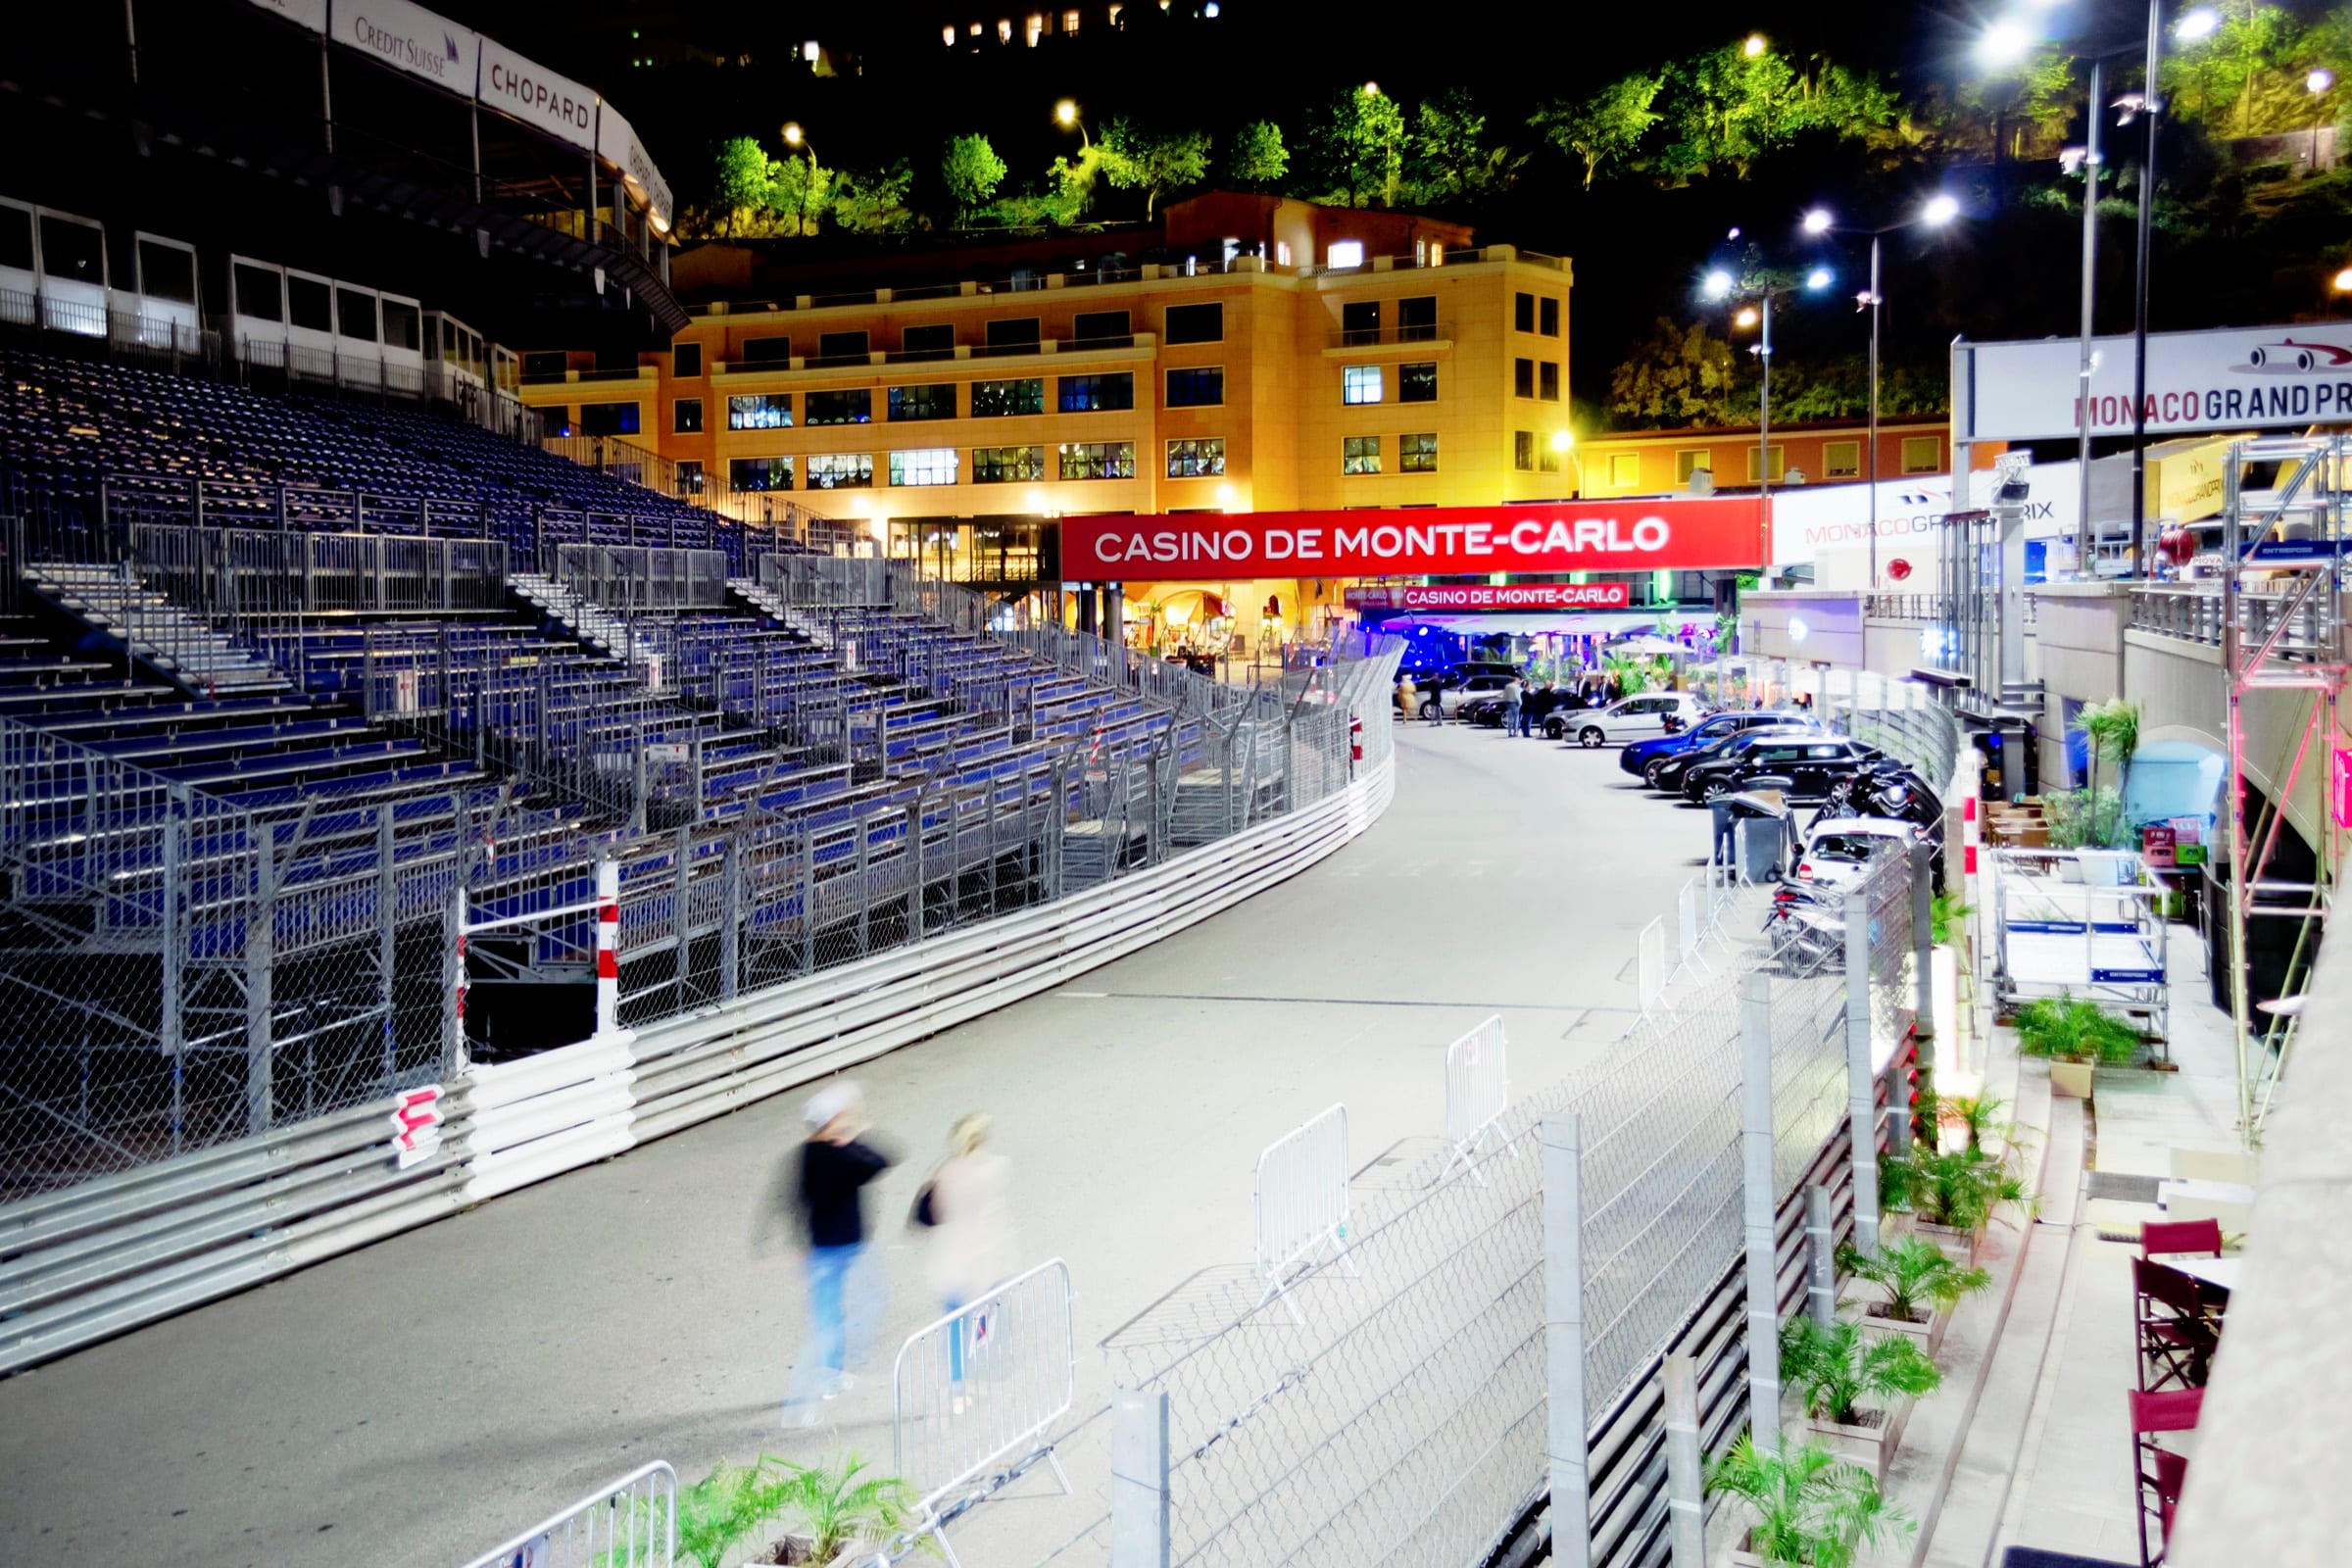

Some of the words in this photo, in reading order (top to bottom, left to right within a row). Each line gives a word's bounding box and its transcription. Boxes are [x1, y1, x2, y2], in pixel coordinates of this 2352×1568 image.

[355, 17, 404, 58] CREDIT
[407, 38, 445, 77] SUISSE
[492, 64, 588, 129] CHOPARD
[1095, 530, 1253, 563] CASINO
[1265, 528, 1323, 559] DE
[1335, 516, 1668, 558] MONTE-CARLO
[1406, 590, 1467, 605] CASINO
[1471, 590, 1492, 604] DE
[1496, 589, 1622, 603] MONTE-CARLO
